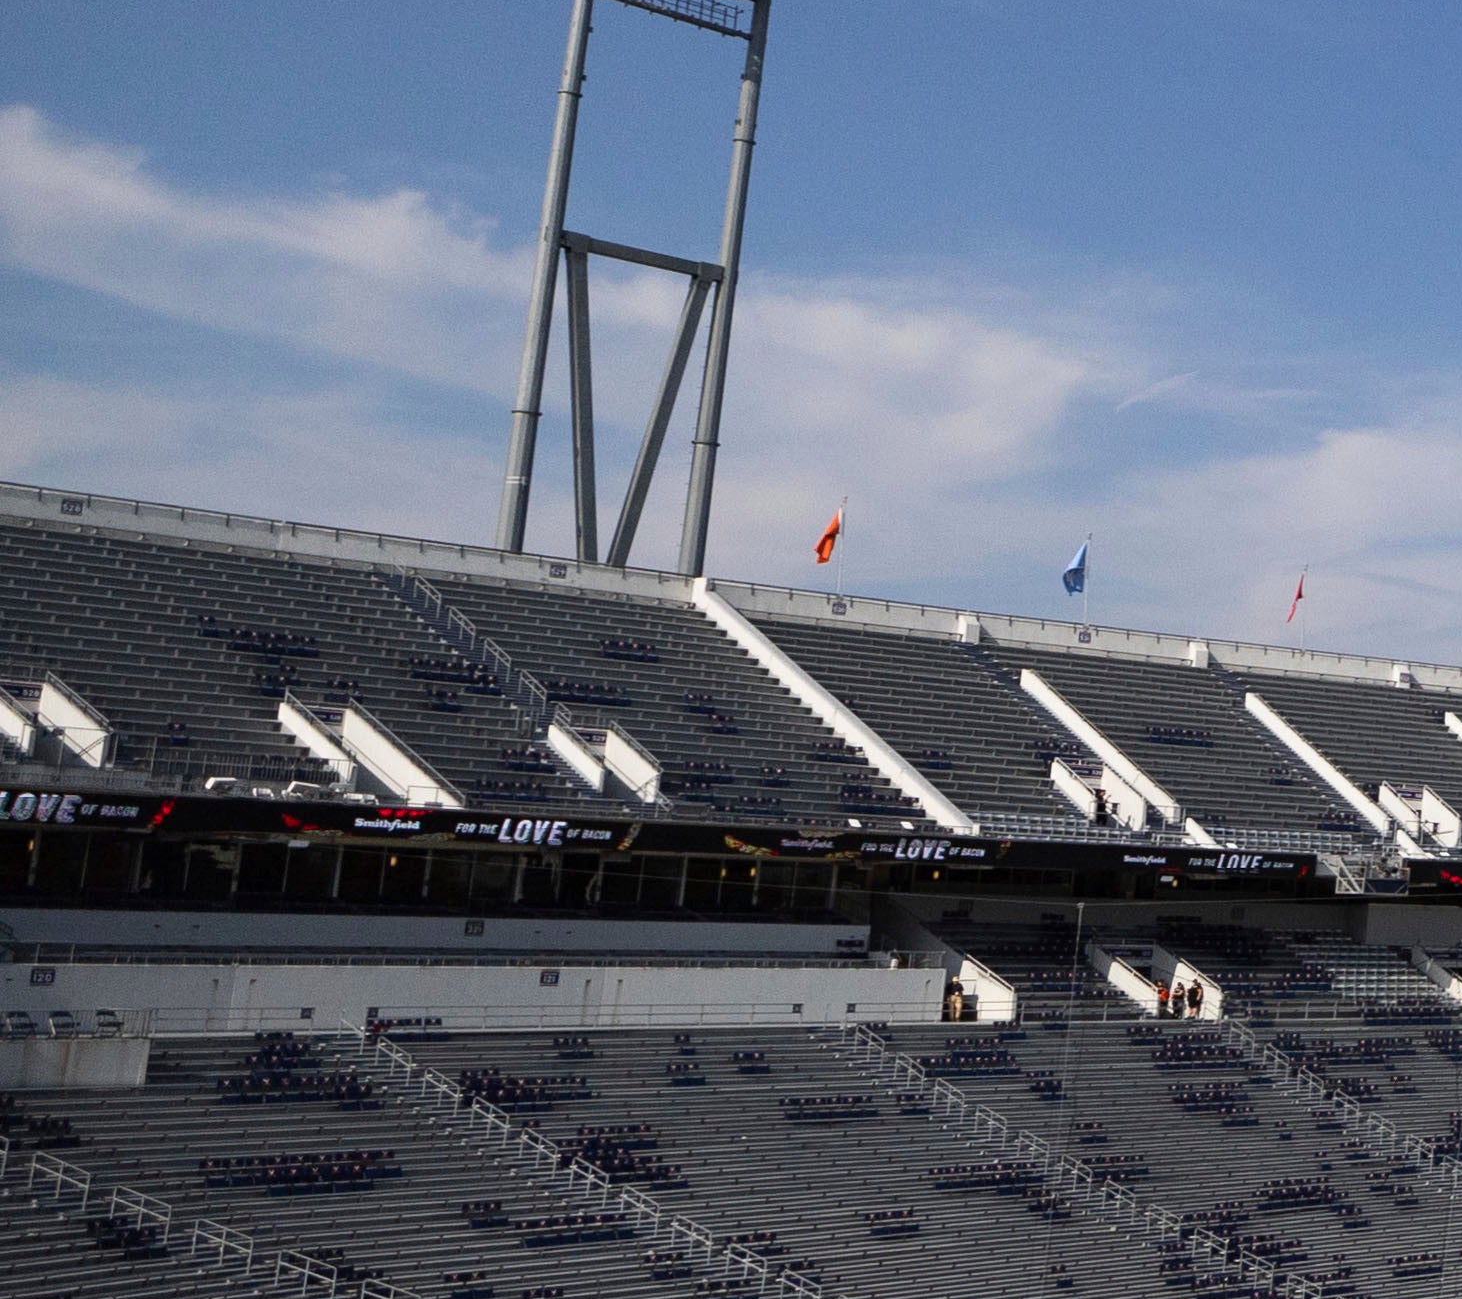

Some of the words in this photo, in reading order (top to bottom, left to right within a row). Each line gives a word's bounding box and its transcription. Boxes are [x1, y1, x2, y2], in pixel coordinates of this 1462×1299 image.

[81, 803, 98, 817] OF
[100, 804, 139, 819] BACON
[354, 818, 421, 831] Smithfield
[455, 822, 475, 834] FOR
[478, 823, 498, 835] THE
[498, 818, 568, 846] LOVE
[567, 828, 579, 839] OF
[582, 829, 612, 841] BACON
[895, 838, 950, 860] LOVE
[1123, 854, 1167, 866] Smithfield
[1216, 853, 1263, 869] LOVE
[32, 972, 52, 982] 120
